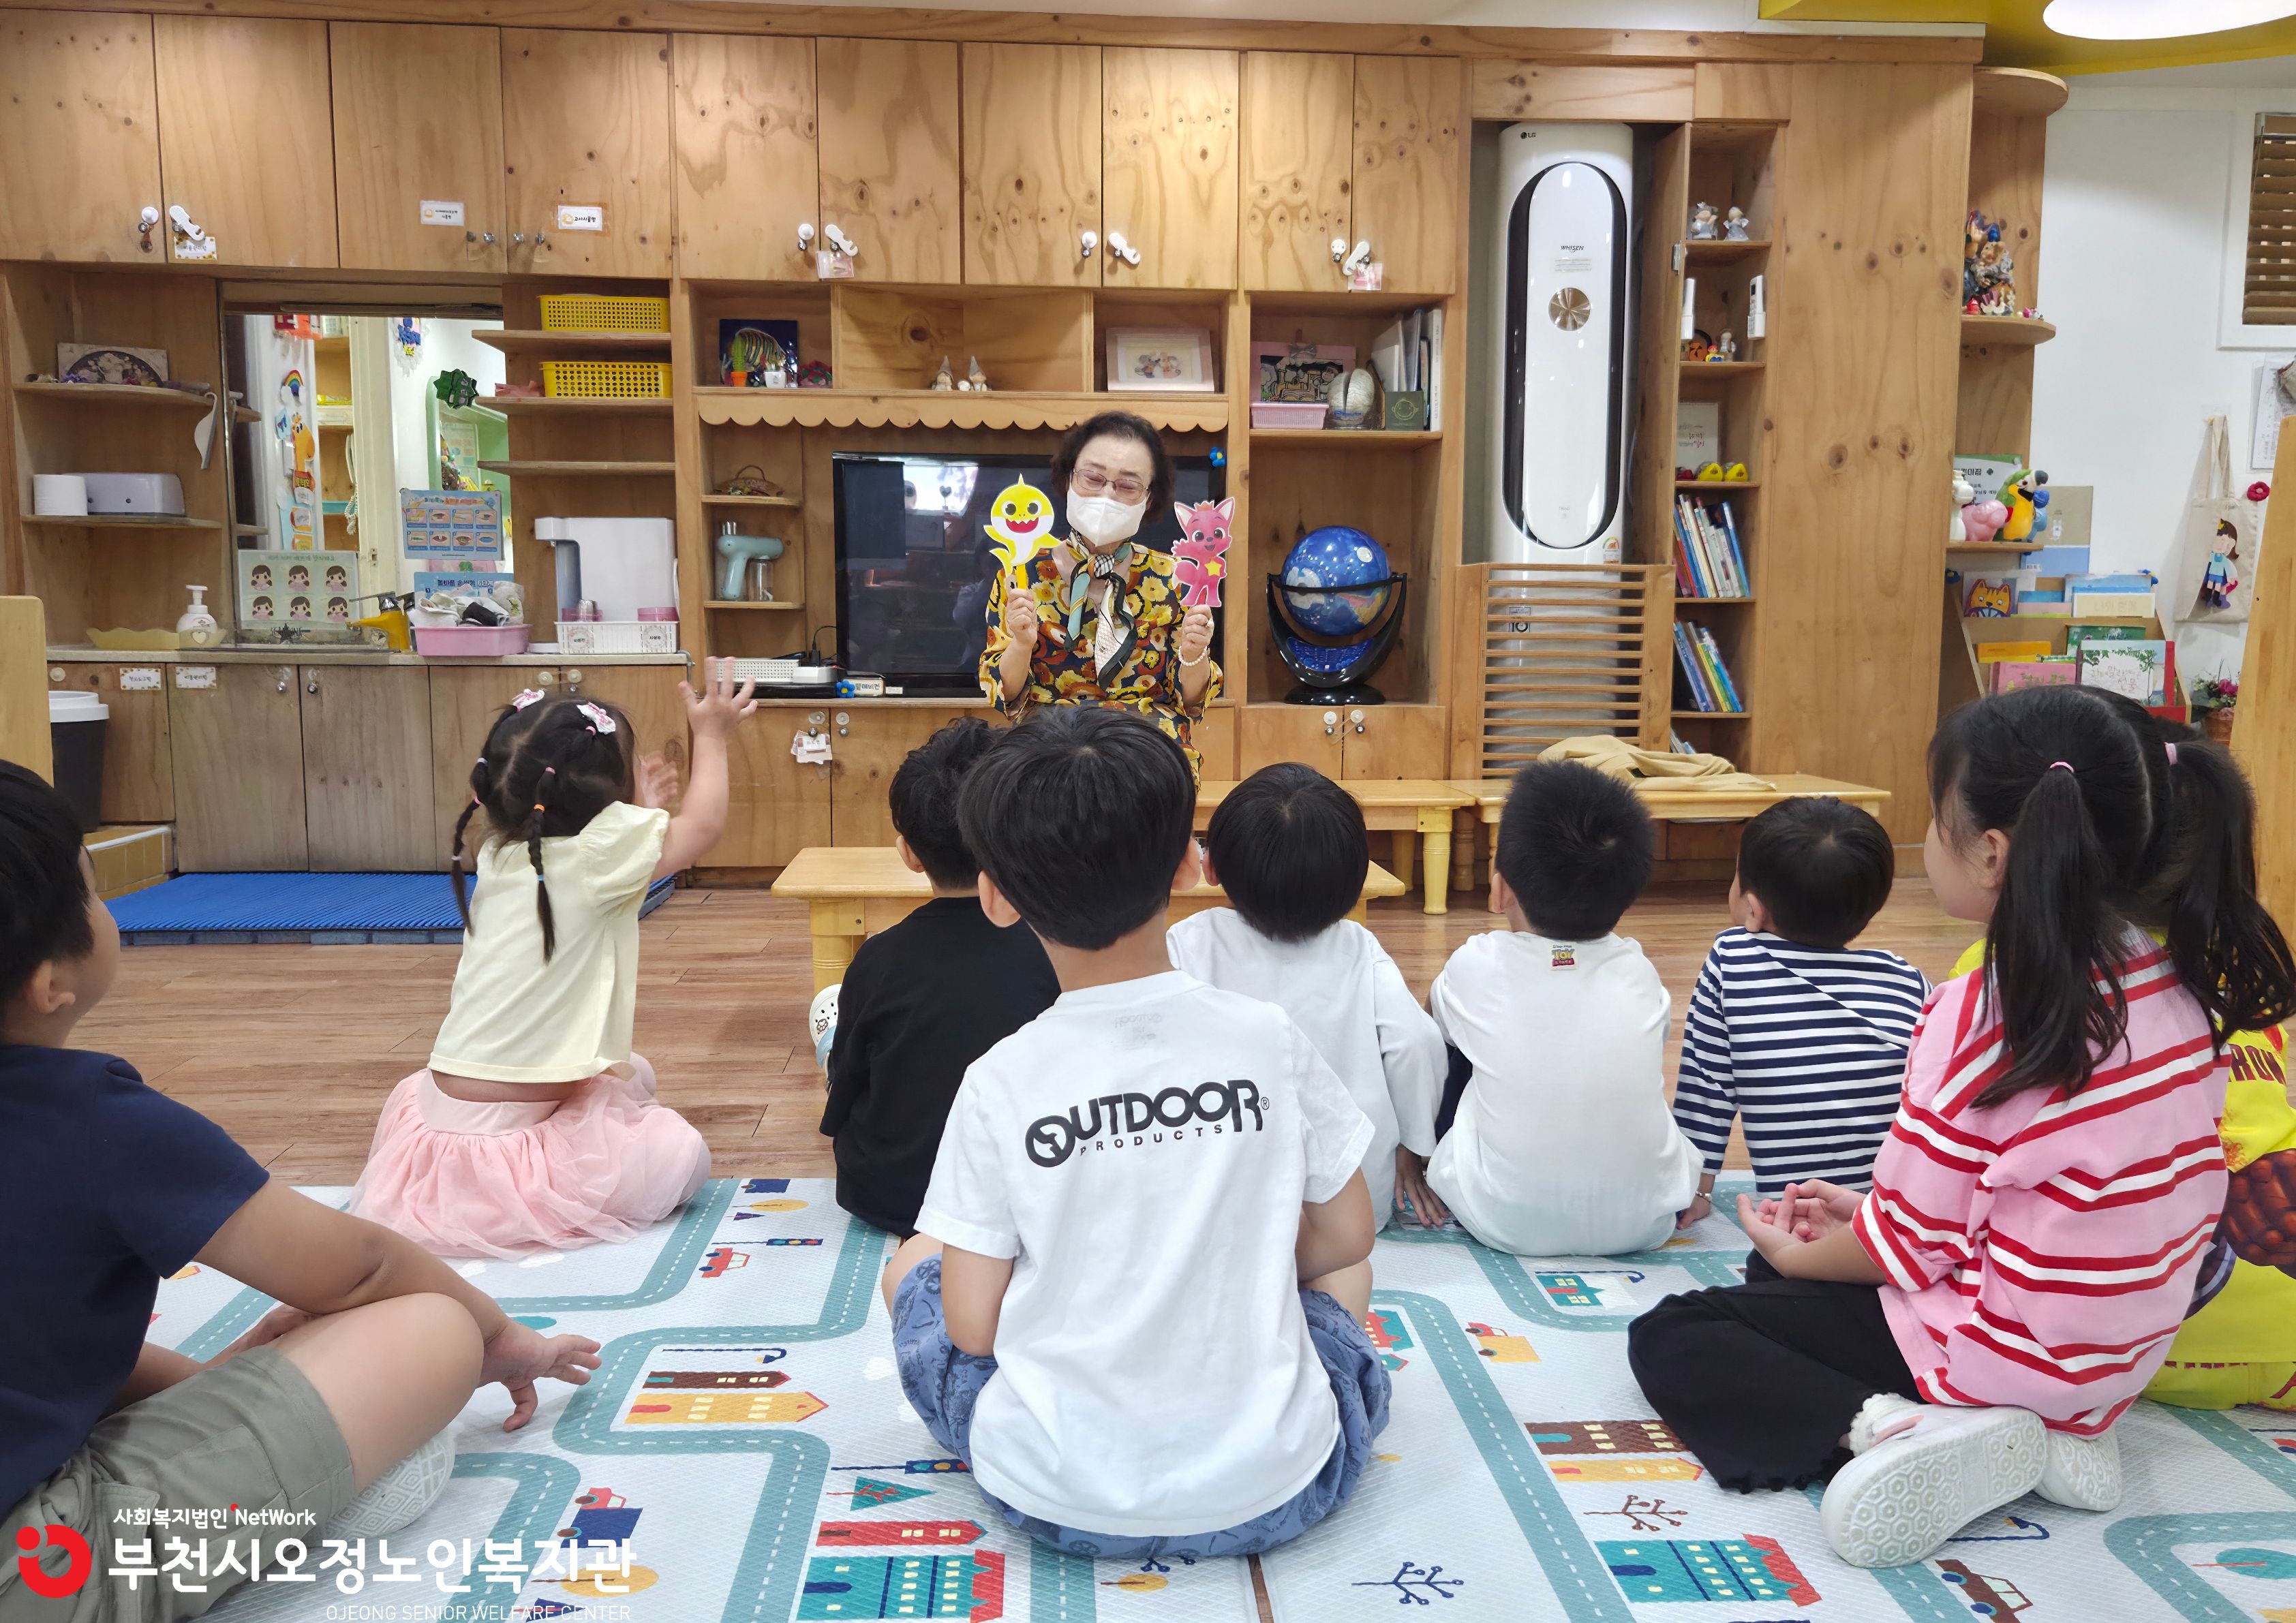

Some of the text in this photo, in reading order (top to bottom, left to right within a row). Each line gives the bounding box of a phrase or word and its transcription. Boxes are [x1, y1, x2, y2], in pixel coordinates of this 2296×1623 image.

[1561, 245, 1585, 253] WHISEN
[2226, 1043, 2286, 1085] RON
[1025, 1079, 1264, 1168] OUTDOOR
[1080, 1124, 1223, 1156] PRODUCTS
